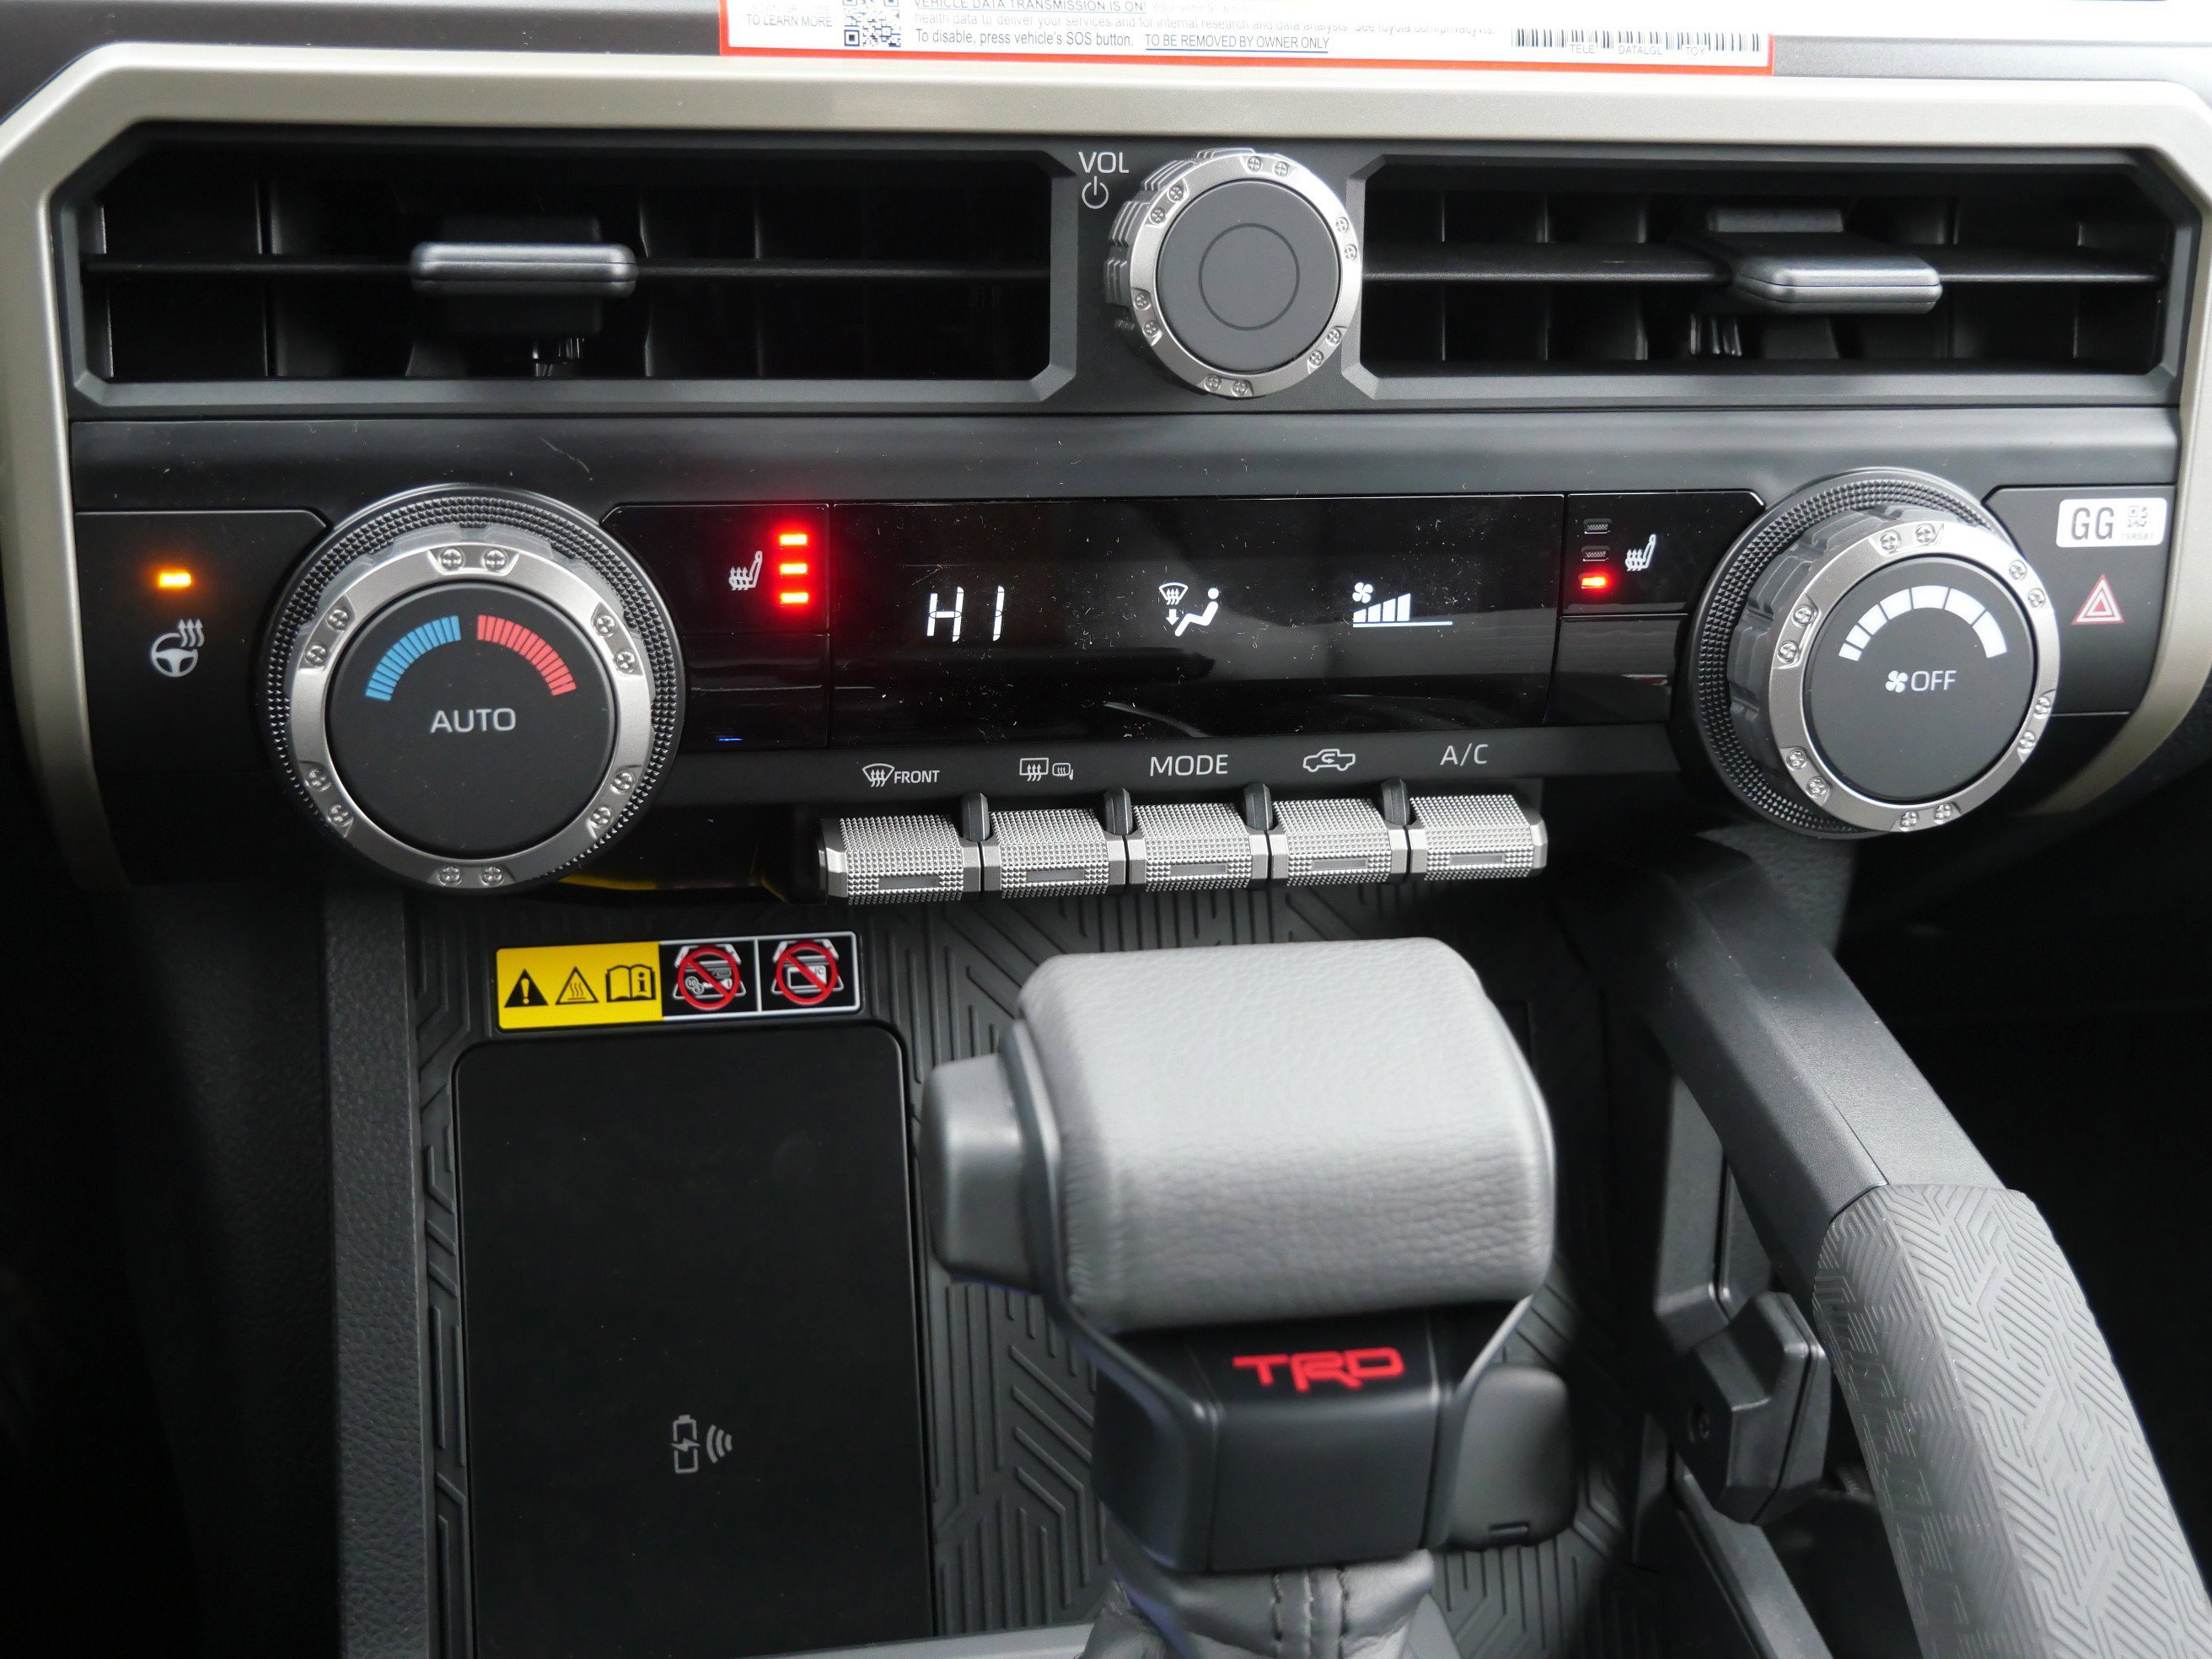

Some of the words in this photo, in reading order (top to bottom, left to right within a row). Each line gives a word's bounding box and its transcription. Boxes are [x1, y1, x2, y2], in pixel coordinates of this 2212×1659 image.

[915, 0, 969, 8] VEHICLE
[974, 0, 1007, 9] DATA
[1011, 0, 1106, 11] TRANSMISSION
[1110, 1, 1121, 12] IS
[747, 14, 760, 26] TO
[764, 14, 799, 27] LEARN
[802, 16, 833, 28] MORE
[915, 13, 949, 24] health
[953, 14, 978, 25] data
[982, 14, 992, 25] to
[997, 15, 1034, 26] deliver
[1038, 18, 1063, 29] your
[1066, 16, 1112, 27] services
[1115, 17, 1136, 28] and
[1139, 18, 1153, 28] for
[1157, 18, 1198, 29] internal
[1202, 19, 1249, 30] research
[915, 29, 929, 42] To
[932, 30, 976, 45] disable,
[980, 33, 1011, 46] press
[1014, 31, 1062, 46] vehicle's
[1066, 32, 1092, 46] SOS
[1096, 32, 1134, 46] button.
[1146, 35, 1160, 46] TO
[1162, 35, 1178, 47] BE
[1181, 35, 1237, 48] REMOVED
[1239, 36, 1254, 48] BY
[1256, 36, 1298, 49] OWNER
[1301, 37, 1329, 49] ONLY
[1569, 44, 1596, 54] TELE
[1685, 46, 1705, 56] TOY
[1077, 149, 1130, 174] VOL
[2070, 507, 2115, 541] GG
[1910, 670, 1957, 692] OFF
[429, 707, 517, 733] AUTO
[1150, 754, 1229, 777] MODE
[1439, 743, 1489, 767] A/C
[894, 768, 940, 784] FRONT
[1232, 1346, 1405, 1392] TRD
